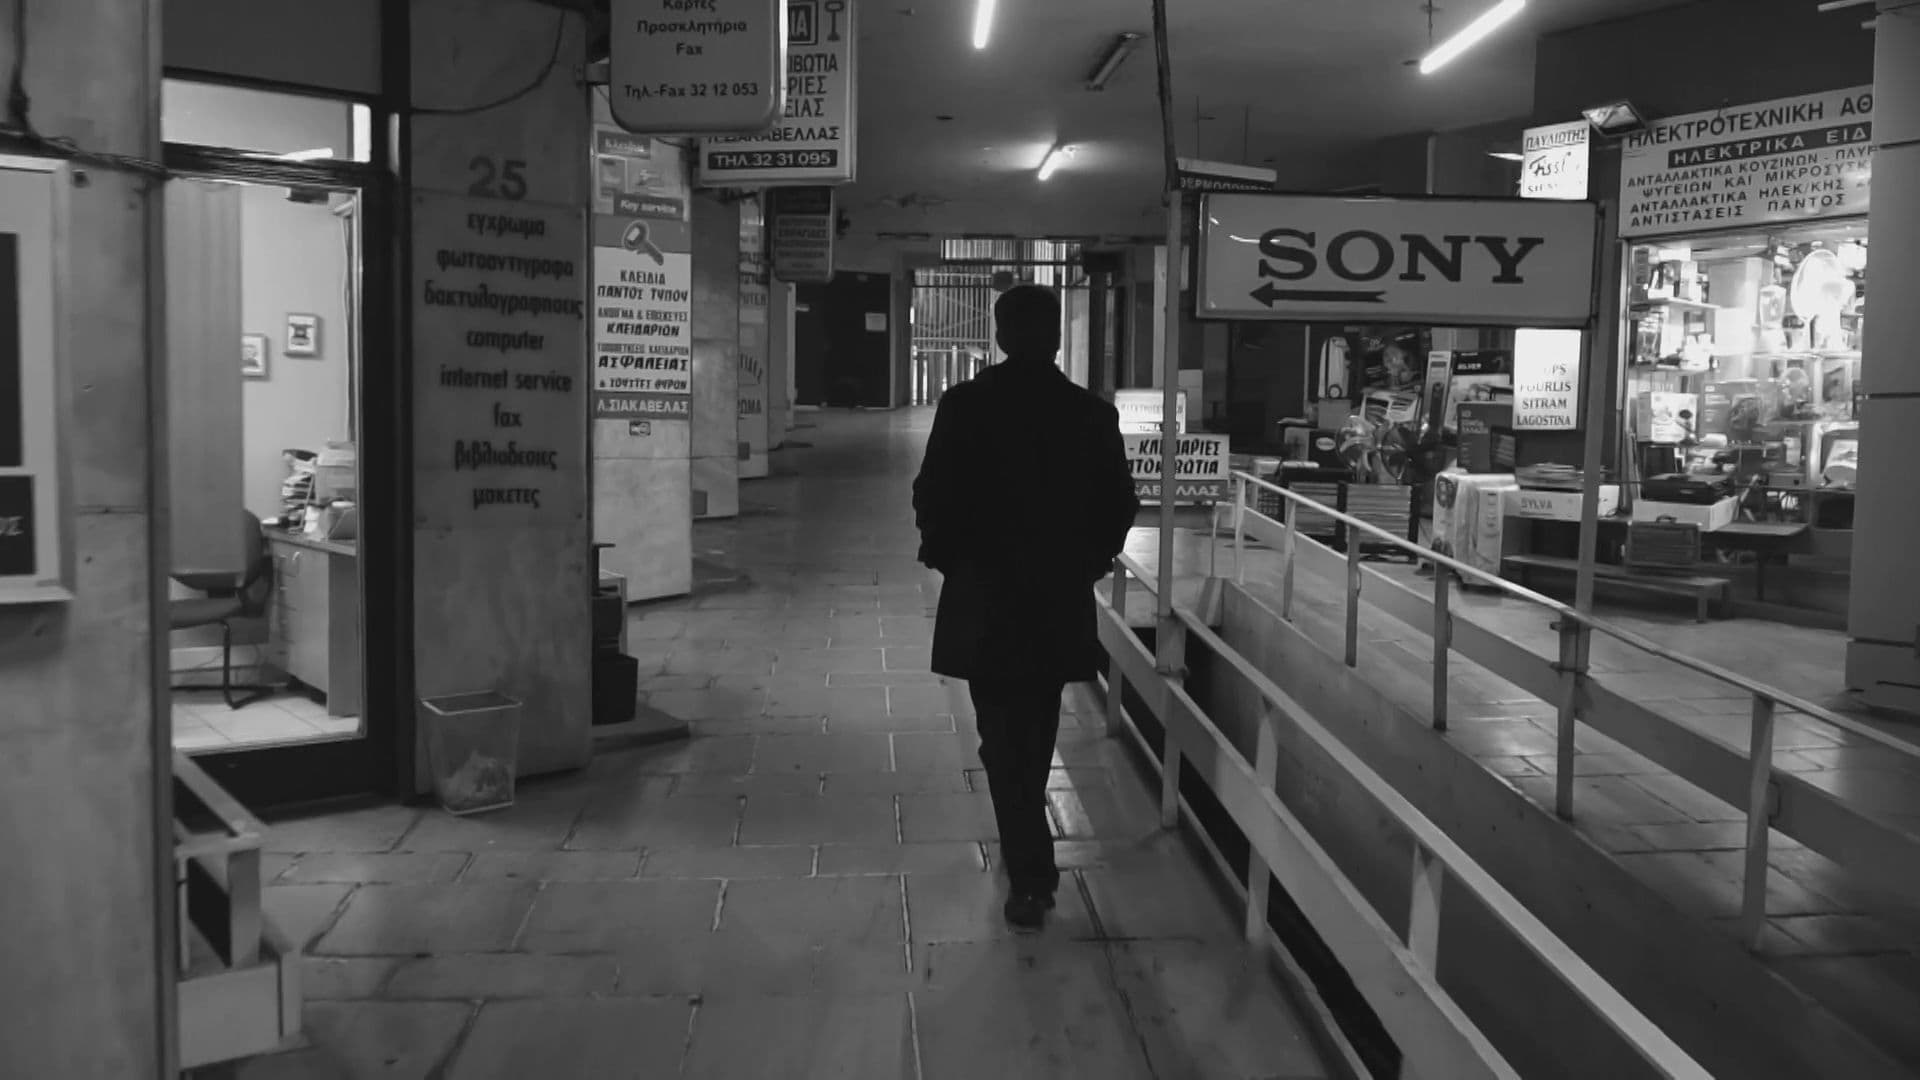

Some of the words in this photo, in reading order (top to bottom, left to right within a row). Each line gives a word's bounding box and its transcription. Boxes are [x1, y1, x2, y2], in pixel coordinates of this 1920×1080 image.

[676, 43, 703, 56] Fax
[691, 84, 706, 97] 32
[713, 84, 729, 97] 12
[733, 83, 758, 97] 053
[1629, 101, 1823, 148] ΗΛΕΚΤΡΟΤΕΧΝΙΚΗ
[776, 153, 793, 166] 31
[798, 152, 831, 166] 095
[1675, 136, 1805, 165] ΗΛΕΚΤΡΙΚΑ
[469, 156, 527, 201] 25
[1627, 164, 1732, 187] ΑΝΤΑΛΛΑΚΤΙΚΑ
[1739, 154, 1818, 173] ΚΟΥΖΙΝΩΝ
[1643, 181, 1712, 198] ΨΥΓΕΙΩΝ
[1724, 175, 1752, 188] ΚΑΙ
[1630, 193, 1747, 214] ΑΝΤΑΛΛΑΚΤΙΚΑ
[1631, 206, 1744, 227] ΑΝΤΙΣΤΑΣΕΙΣ
[1768, 194, 1846, 212] ΠΑΝΤΟΣ
[1258, 228, 1544, 284] SONY
[620, 270, 666, 285] ΚΛΕΙΔΙΑ
[598, 285, 643, 300] ΠΑΝΤΟΣ
[651, 289, 688, 302] ΤΥΠΟΥ
[467, 329, 544, 354] computer
[599, 356, 688, 371] ΑΣΦΑΛΕΙΑΣ
[441, 364, 508, 389] internet
[515, 370, 572, 392] service
[494, 402, 522, 427] fax
[1522, 398, 1567, 409] SITRAM
[1516, 415, 1572, 426] LAGOSTINA
[1138, 439, 1221, 456] ΚΛΑΡΙΕΣ
